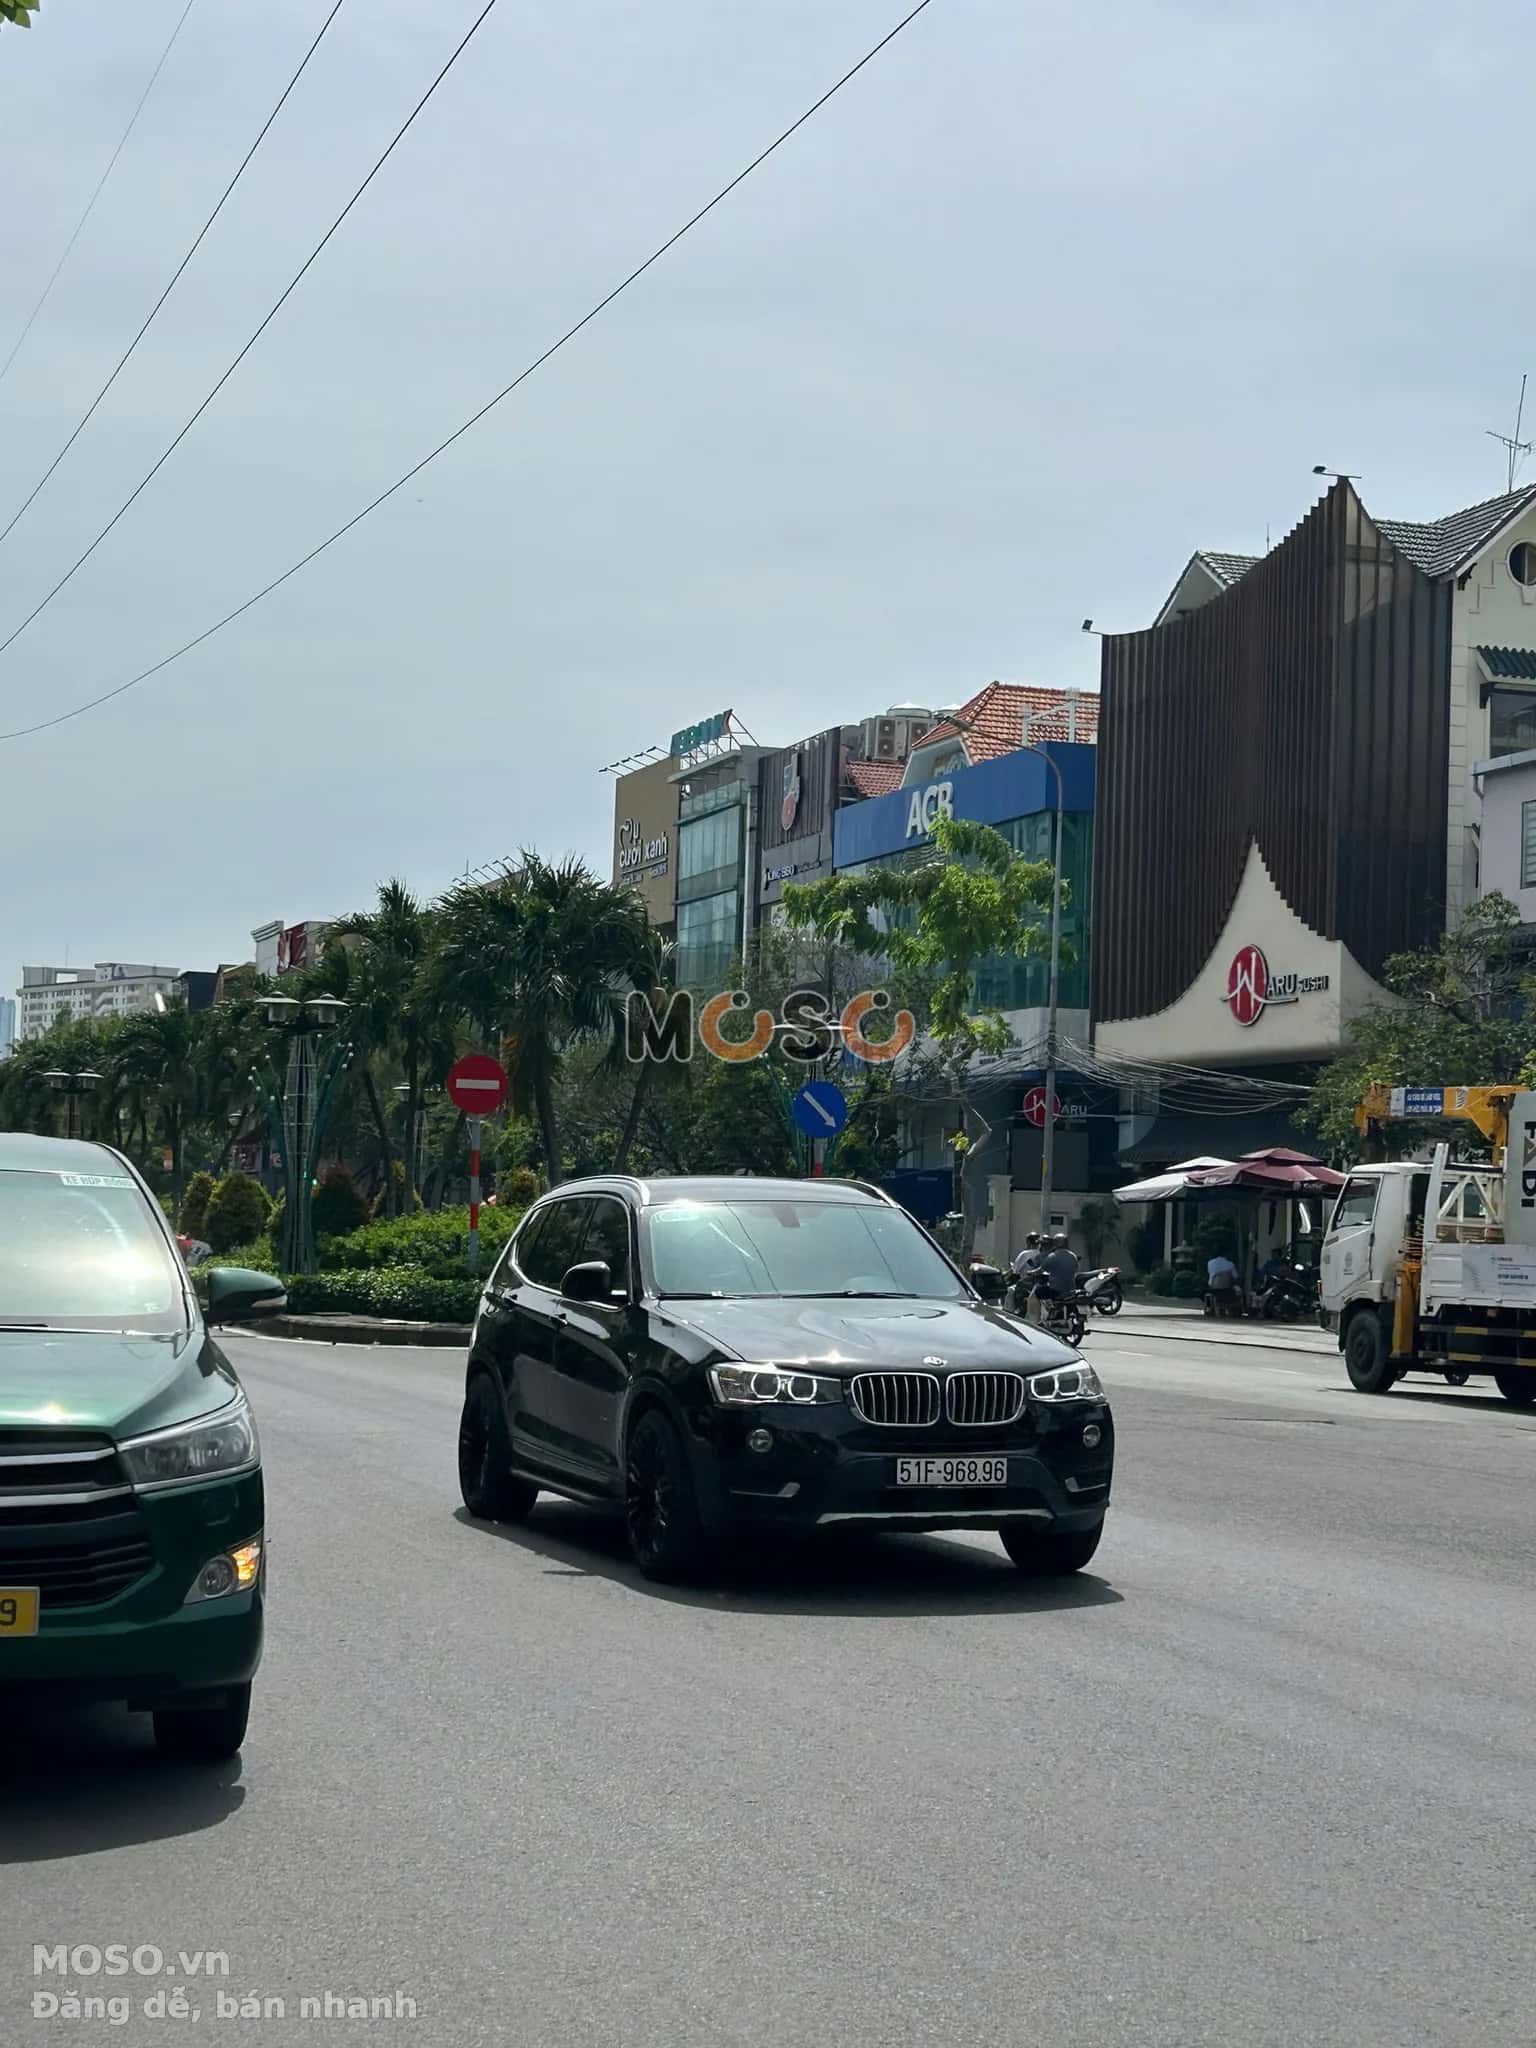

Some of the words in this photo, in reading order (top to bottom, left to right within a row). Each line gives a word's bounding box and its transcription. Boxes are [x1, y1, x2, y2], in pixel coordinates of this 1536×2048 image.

[905, 782, 953, 838] ACB
[645, 832, 668, 860] xanh
[900, 1460, 1004, 1483] 51F-968.96
